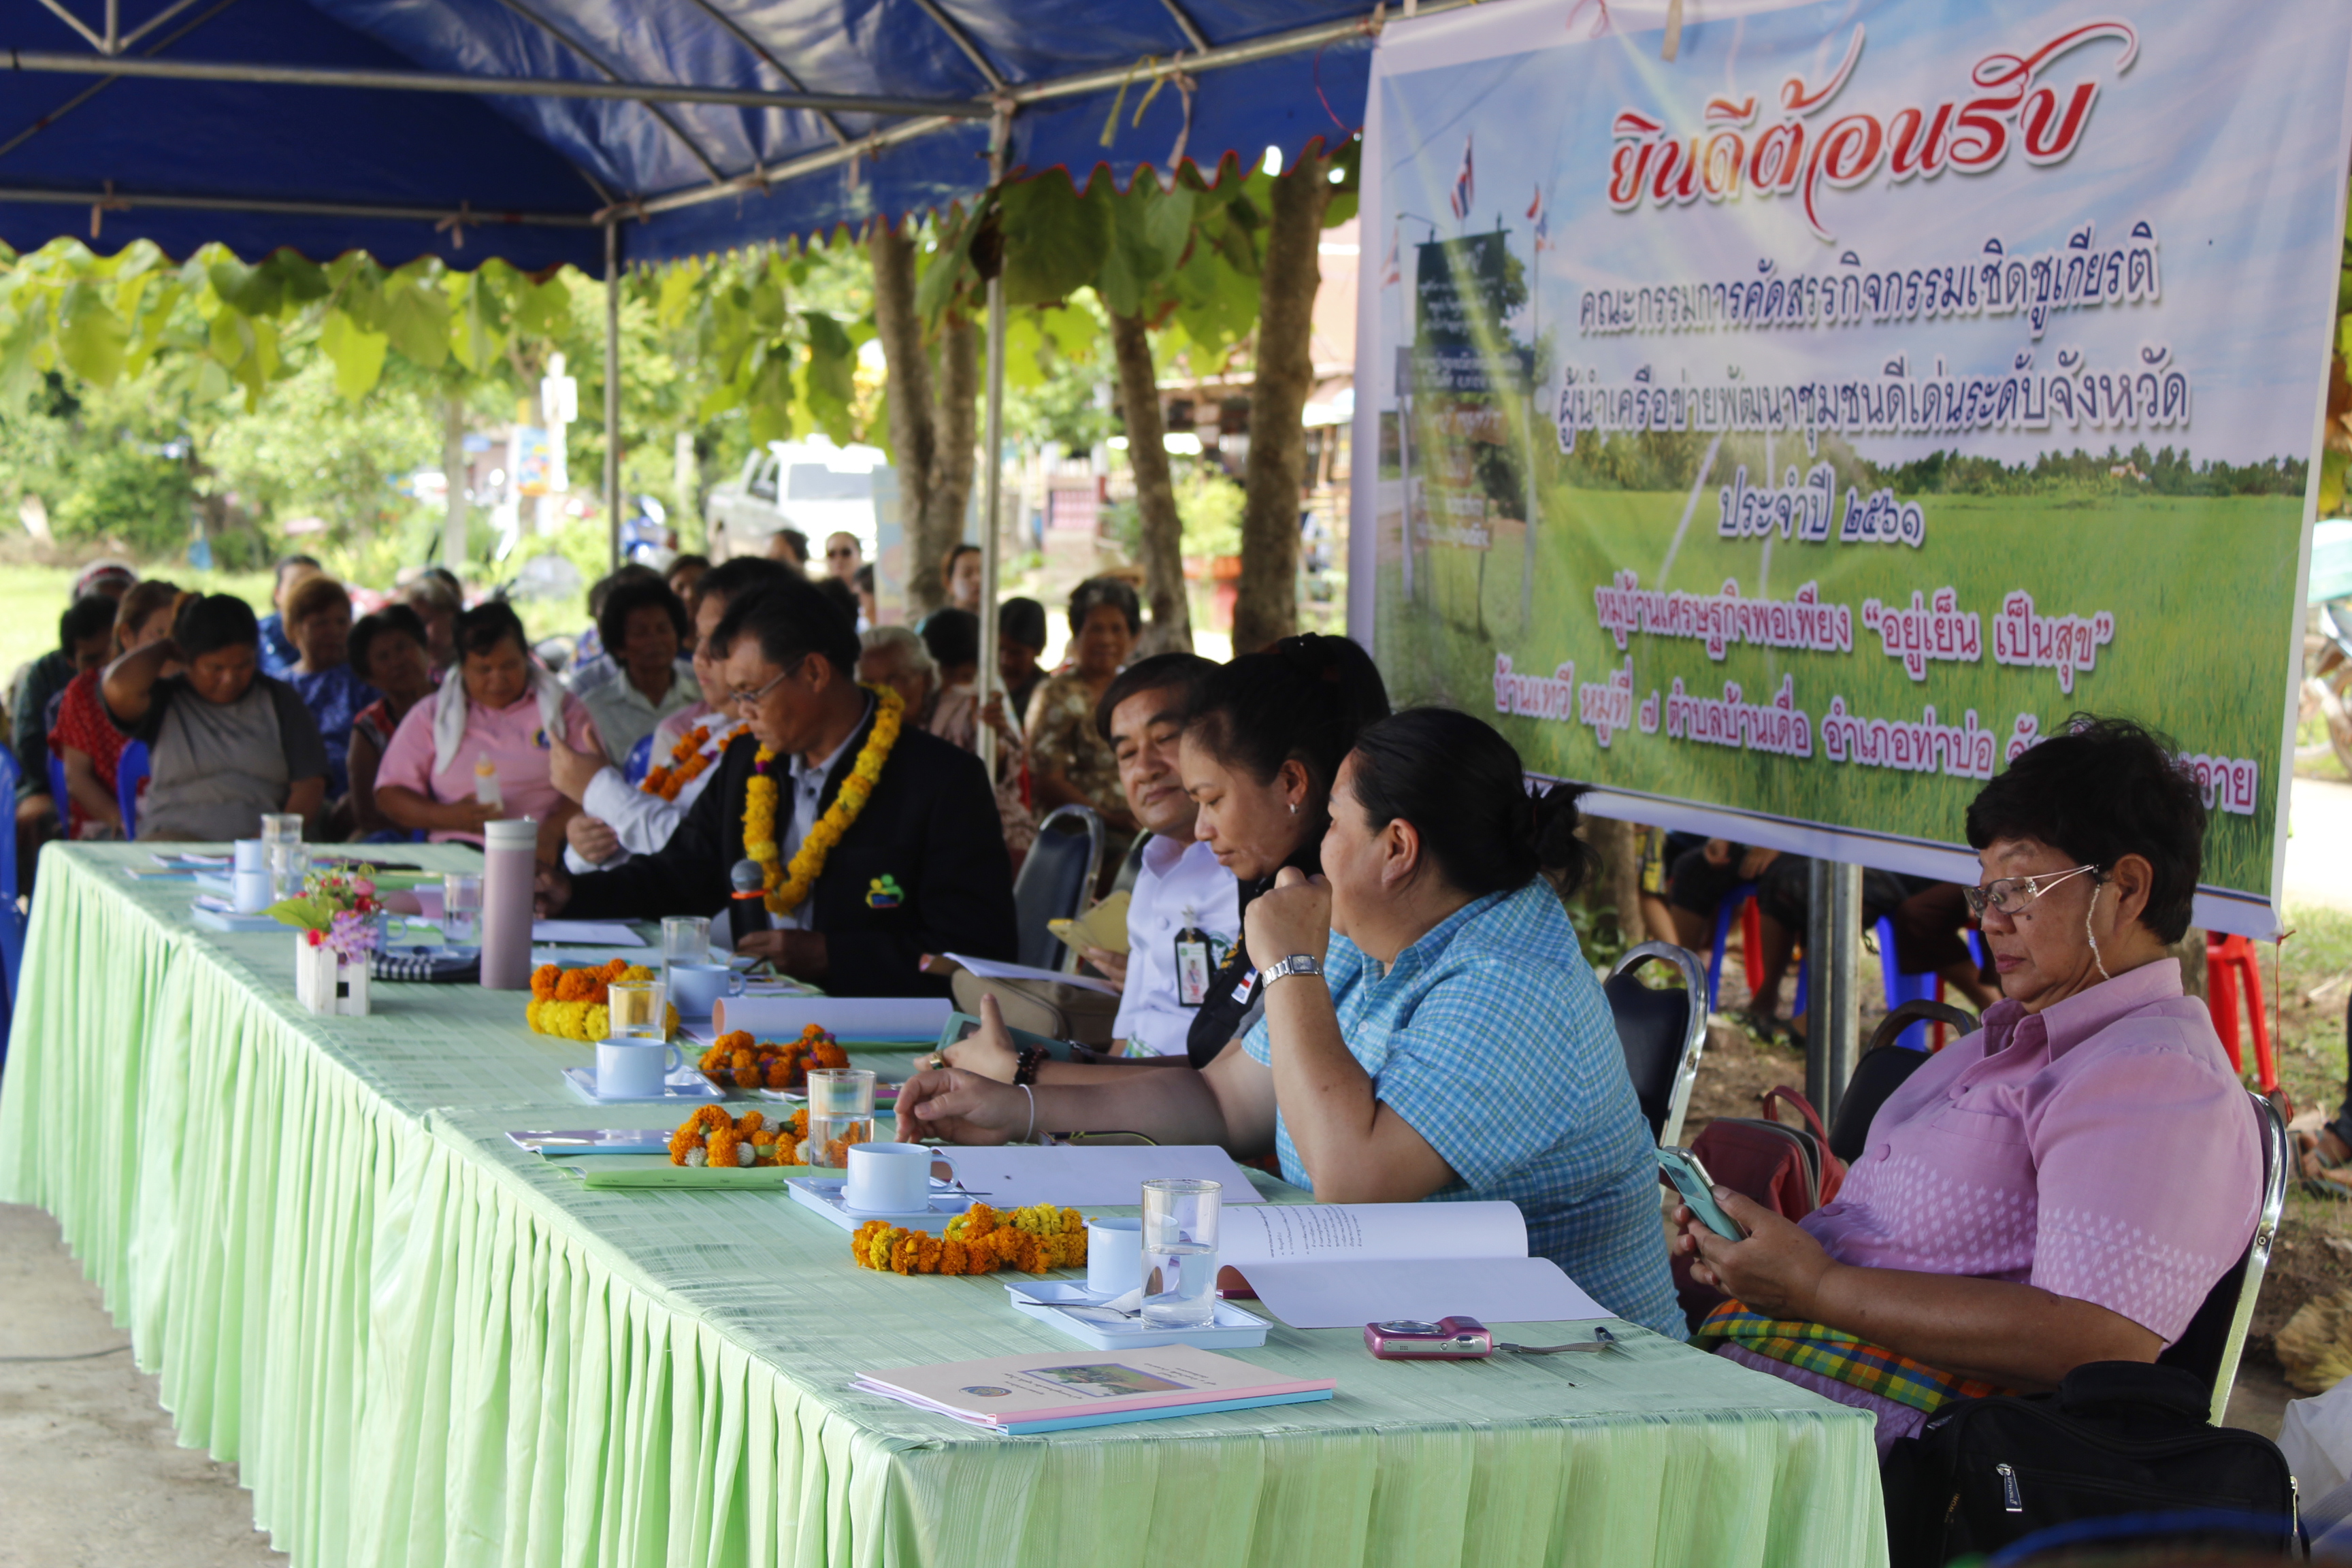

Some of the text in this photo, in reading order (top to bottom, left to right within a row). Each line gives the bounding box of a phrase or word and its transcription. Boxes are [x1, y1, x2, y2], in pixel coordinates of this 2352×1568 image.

[1607, 22, 2136, 240] ยินดีต้อนรับ
[1579, 220, 2155, 332] คณะกรรมการคัดสรรกิจกรรมเชิดชูเกียรติ
[1558, 346, 2187, 449] ผู้นำเครือข่ายพัฒนาชุมชนดีเด่นระดับจังหวัด
[1720, 466, 1921, 541] ประจำปี ๒๕๖๑
[1595, 573, 1850, 655] หมู่บ้านเศรษฐกิจพอเพียง
[1579, 657, 1633, 742] หมู่ที่
[1823, 702, 1994, 773] อำเภอท่าบ่อ
